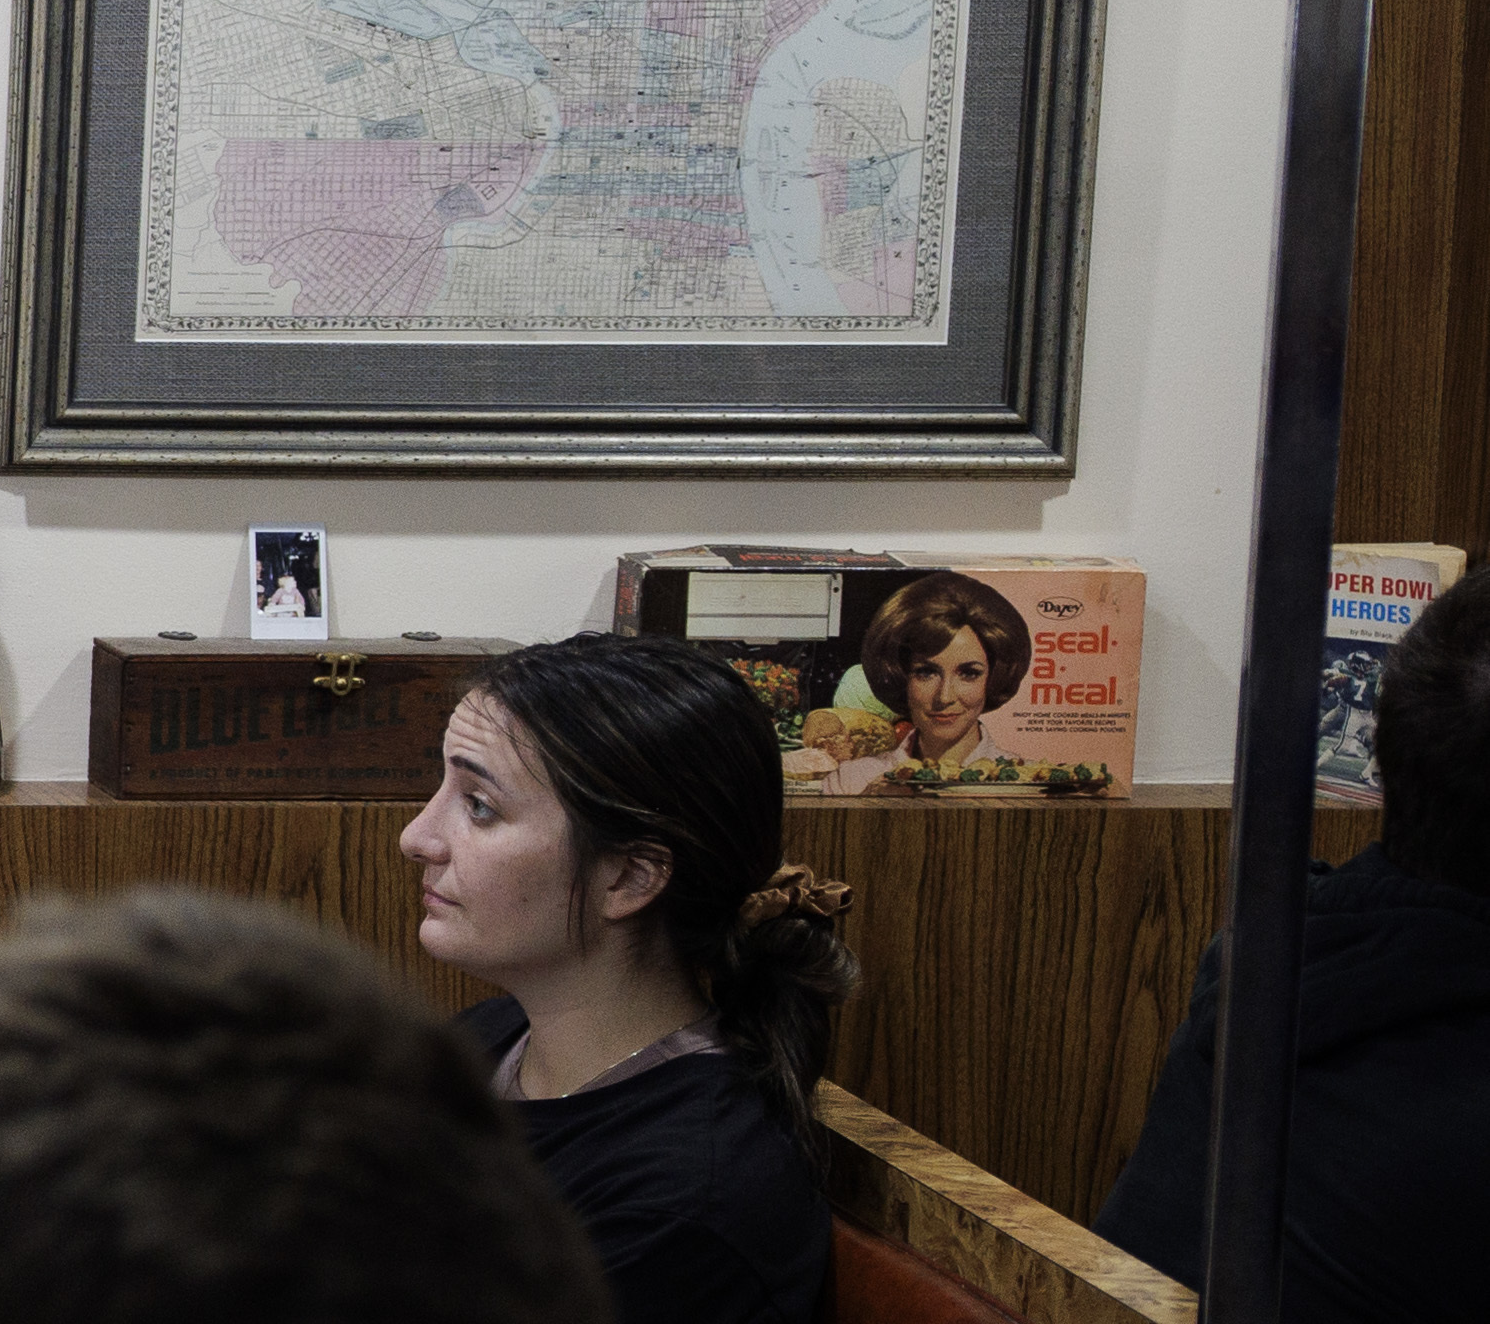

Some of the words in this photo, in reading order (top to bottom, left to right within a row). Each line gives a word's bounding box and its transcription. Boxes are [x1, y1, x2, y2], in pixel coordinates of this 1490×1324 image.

[1381, 577, 1436, 602] BOWL
[1037, 600, 1083, 618] Dazey
[1331, 598, 1412, 625] HEROES
[1350, 628, 1358, 637] by
[1030, 676, 1117, 705] meal
[1352, 679, 1366, 702] 7
